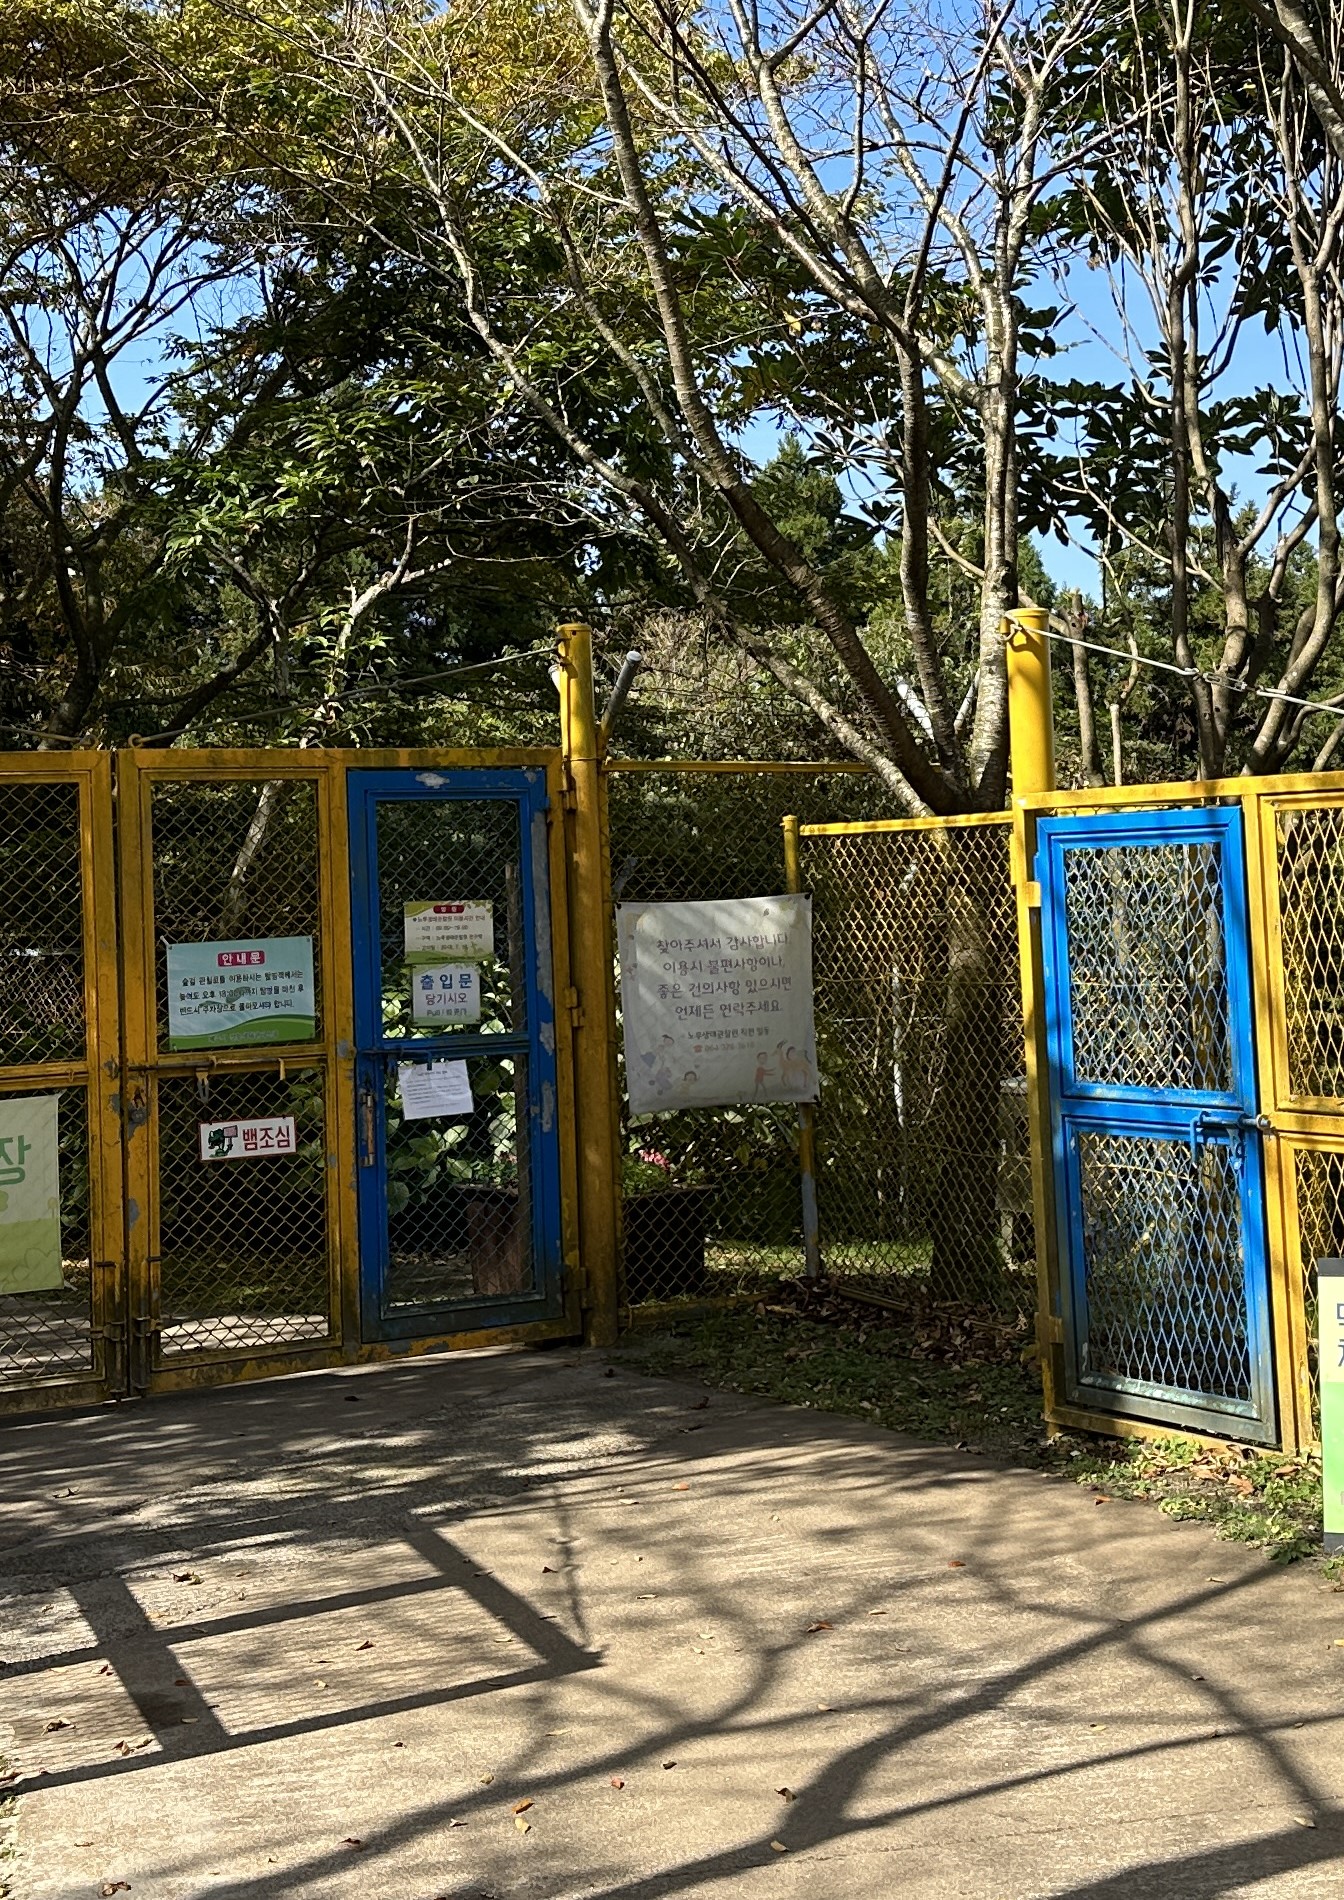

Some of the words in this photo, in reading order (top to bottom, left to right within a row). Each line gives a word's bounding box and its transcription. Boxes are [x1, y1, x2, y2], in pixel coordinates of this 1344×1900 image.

[657, 937, 721, 954] 찾아주셔서
[663, 959, 703, 976] 이용시
[420, 973, 473, 990] 출입문
[657, 983, 683, 999] 좋은
[689, 981, 741, 997] 건의사항
[745, 976, 792, 995] 있으시면
[425, 992, 468, 1006] 당기시오
[675, 1004, 714, 1021] 언제든
[242, 1125, 291, 1152] 뱀조심
